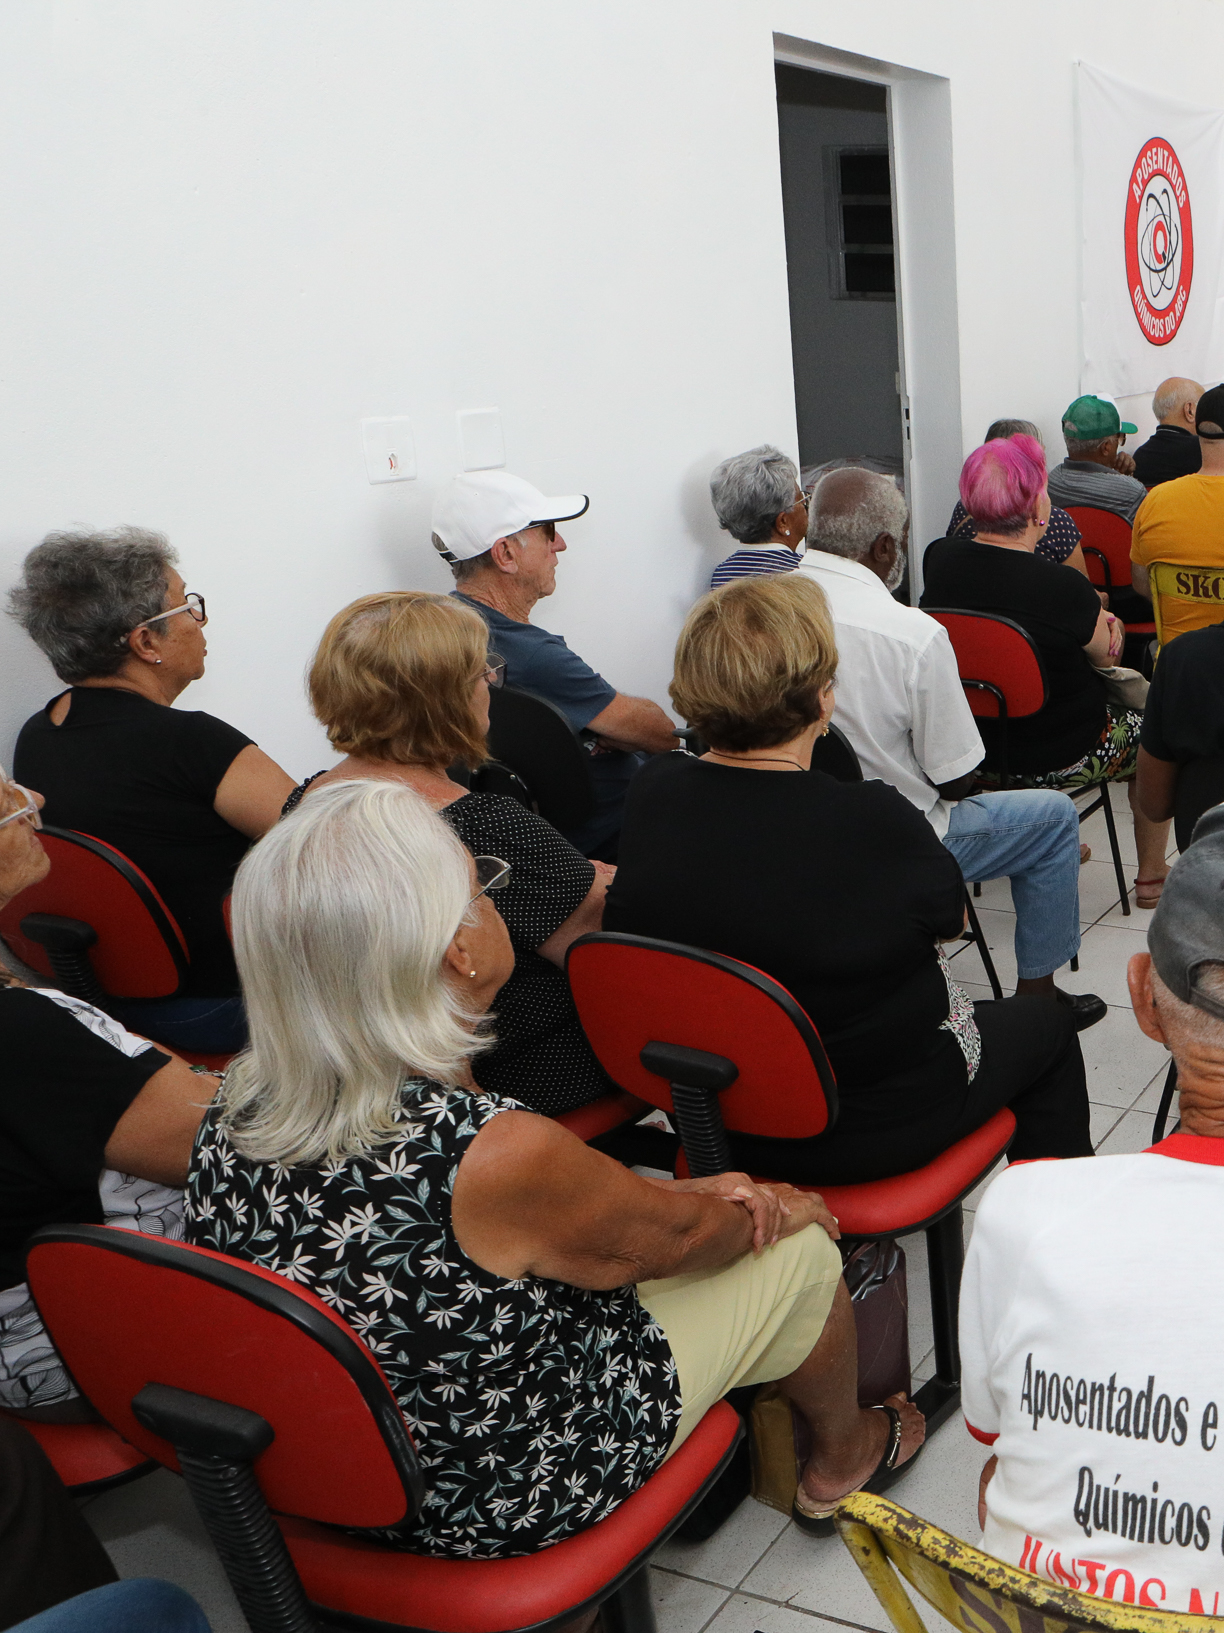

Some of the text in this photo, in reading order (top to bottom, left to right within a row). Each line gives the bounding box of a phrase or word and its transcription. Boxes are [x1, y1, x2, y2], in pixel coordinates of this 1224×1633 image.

[1132, 147, 1187, 208] APOSENTADOS
[1134, 285, 1187, 338] QUÍMICOS DO ABC
[1020, 1353, 1189, 1446] Aposentados
[1200, 1401, 1218, 1451] e
[1073, 1466, 1211, 1551] Químicos
